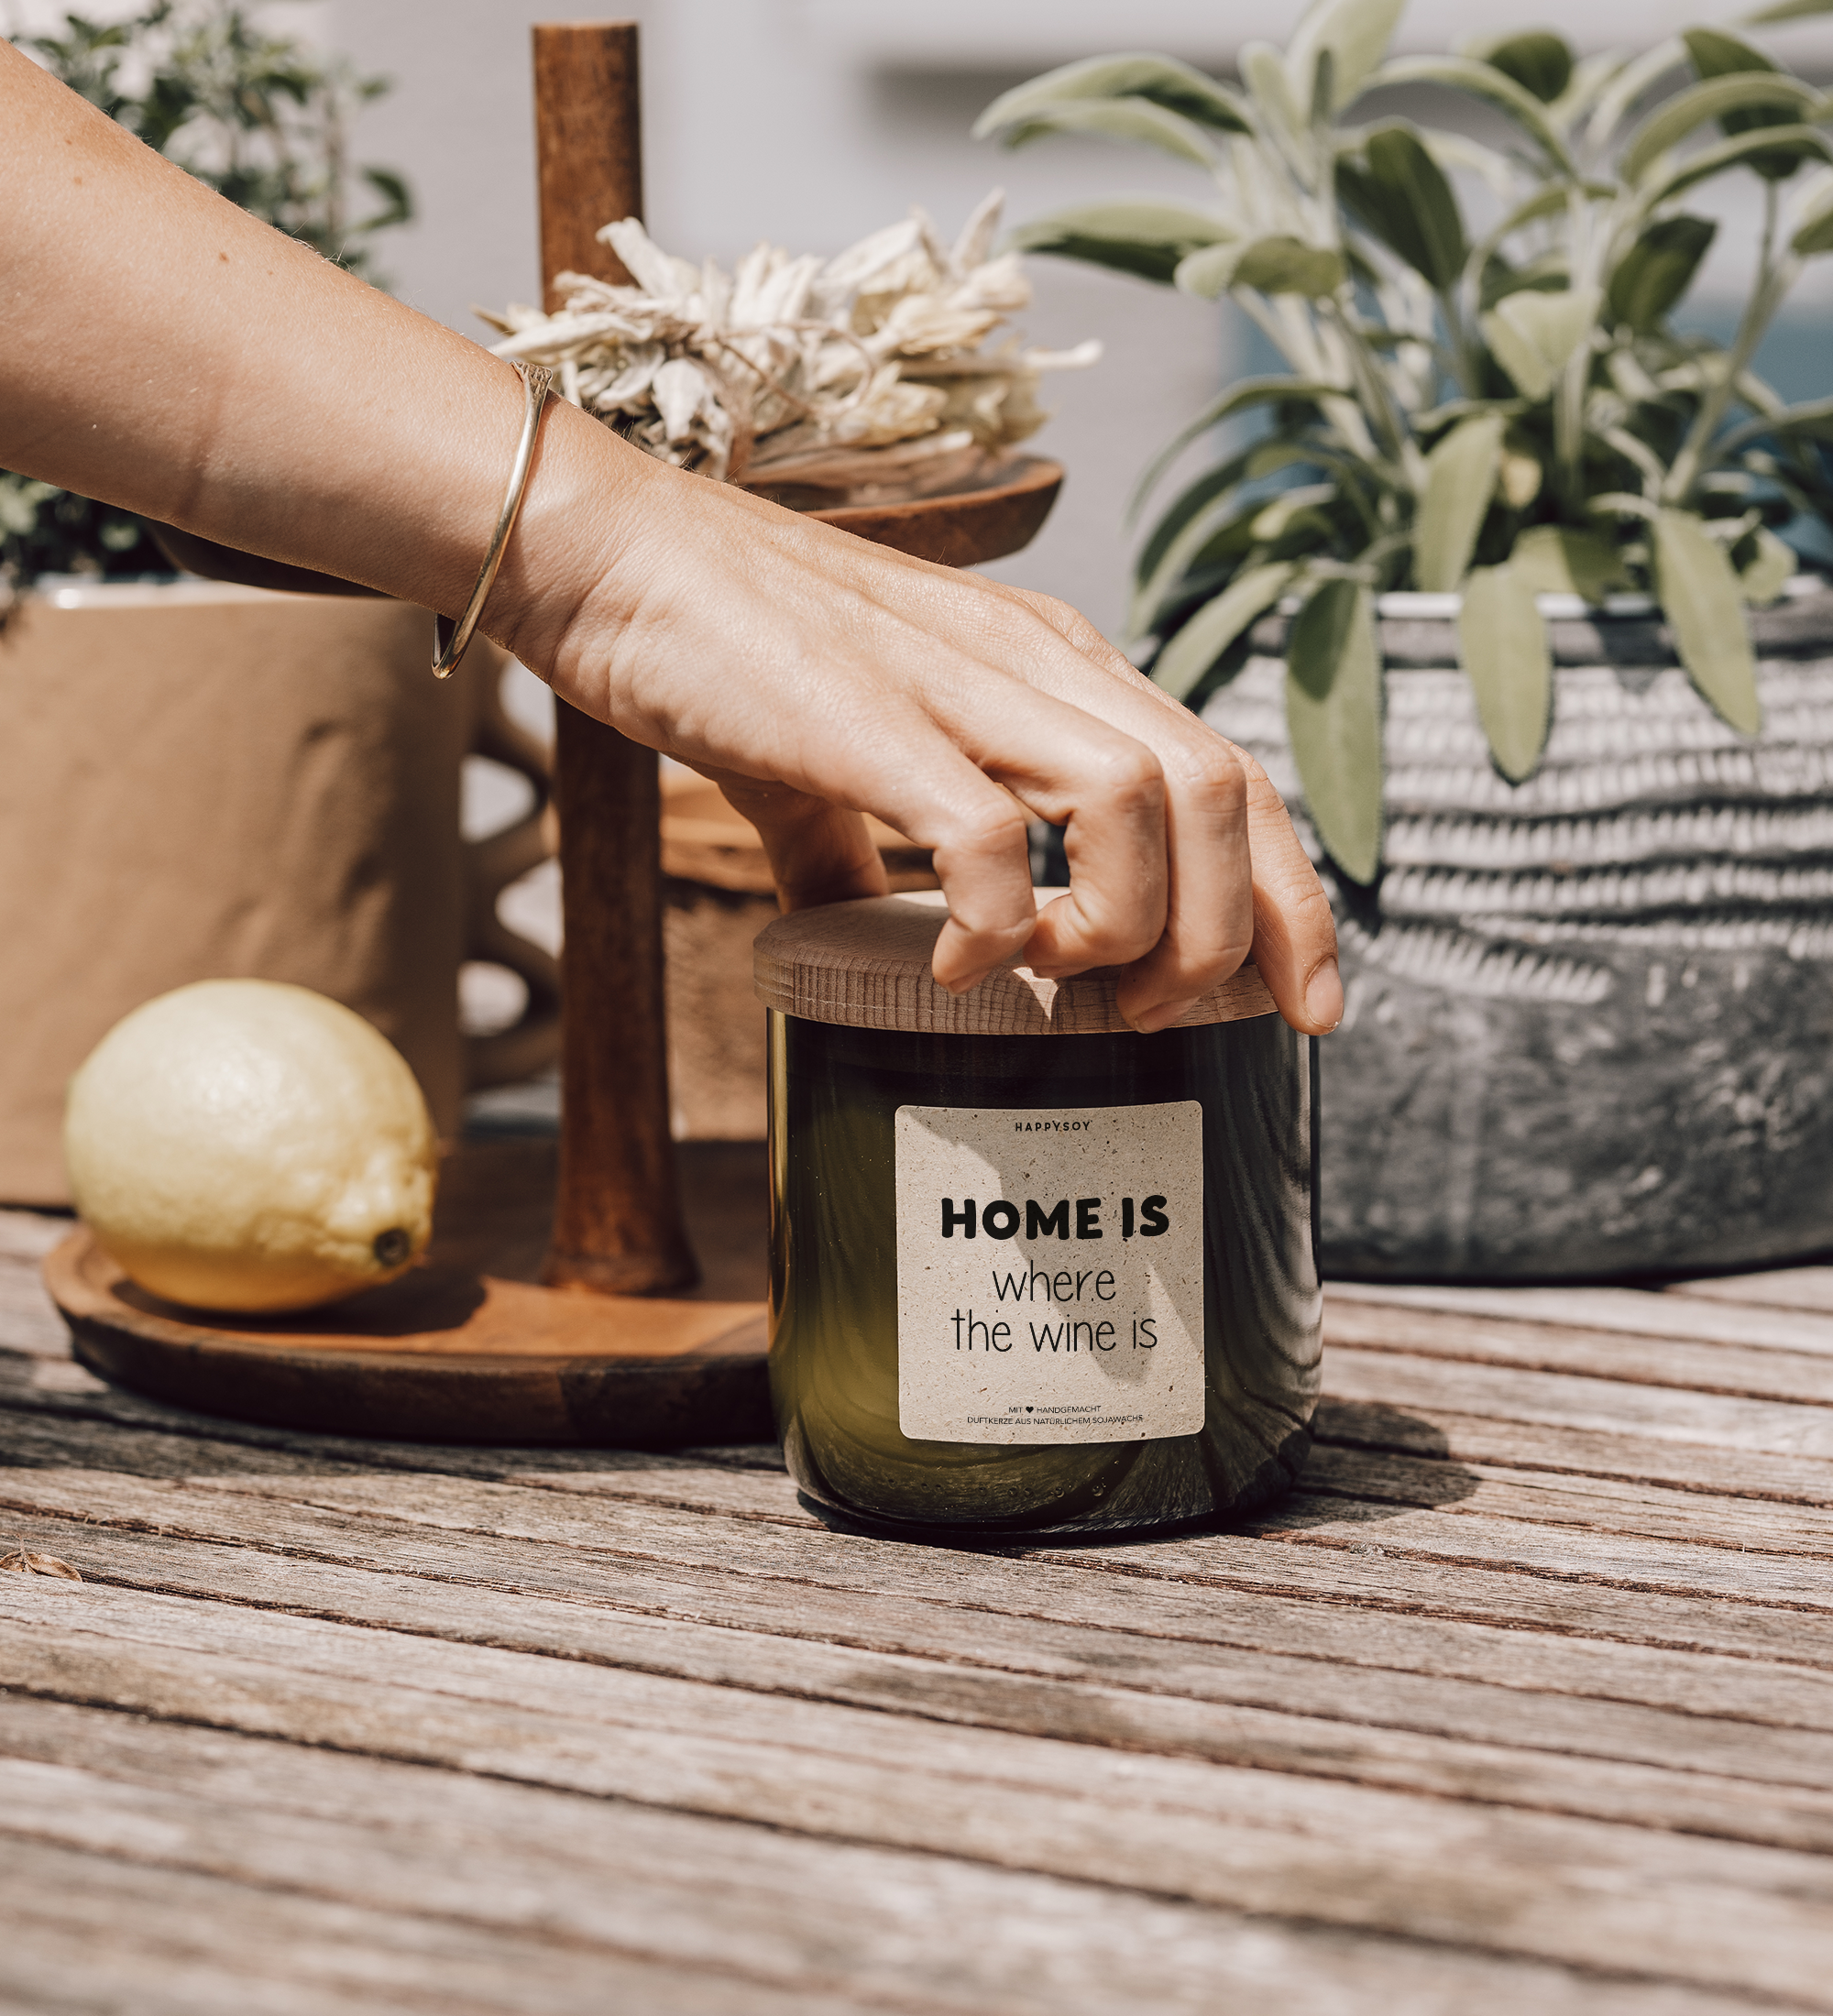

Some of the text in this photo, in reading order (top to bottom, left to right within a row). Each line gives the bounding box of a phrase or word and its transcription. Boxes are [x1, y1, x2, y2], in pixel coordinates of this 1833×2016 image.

[941, 1195, 1169, 1240] HOME IS
[993, 1259, 1116, 1302] where
[950, 1309, 1158, 1353] the wine is
[967, 1416, 1014, 1425] DUFTKERZE
[1033, 1417, 1091, 1425] NATÜRLICHEM
[1092, 1414, 1144, 1424] SOJAWACHS
[1037, 1405, 1102, 1414] HANDGEMACHT
